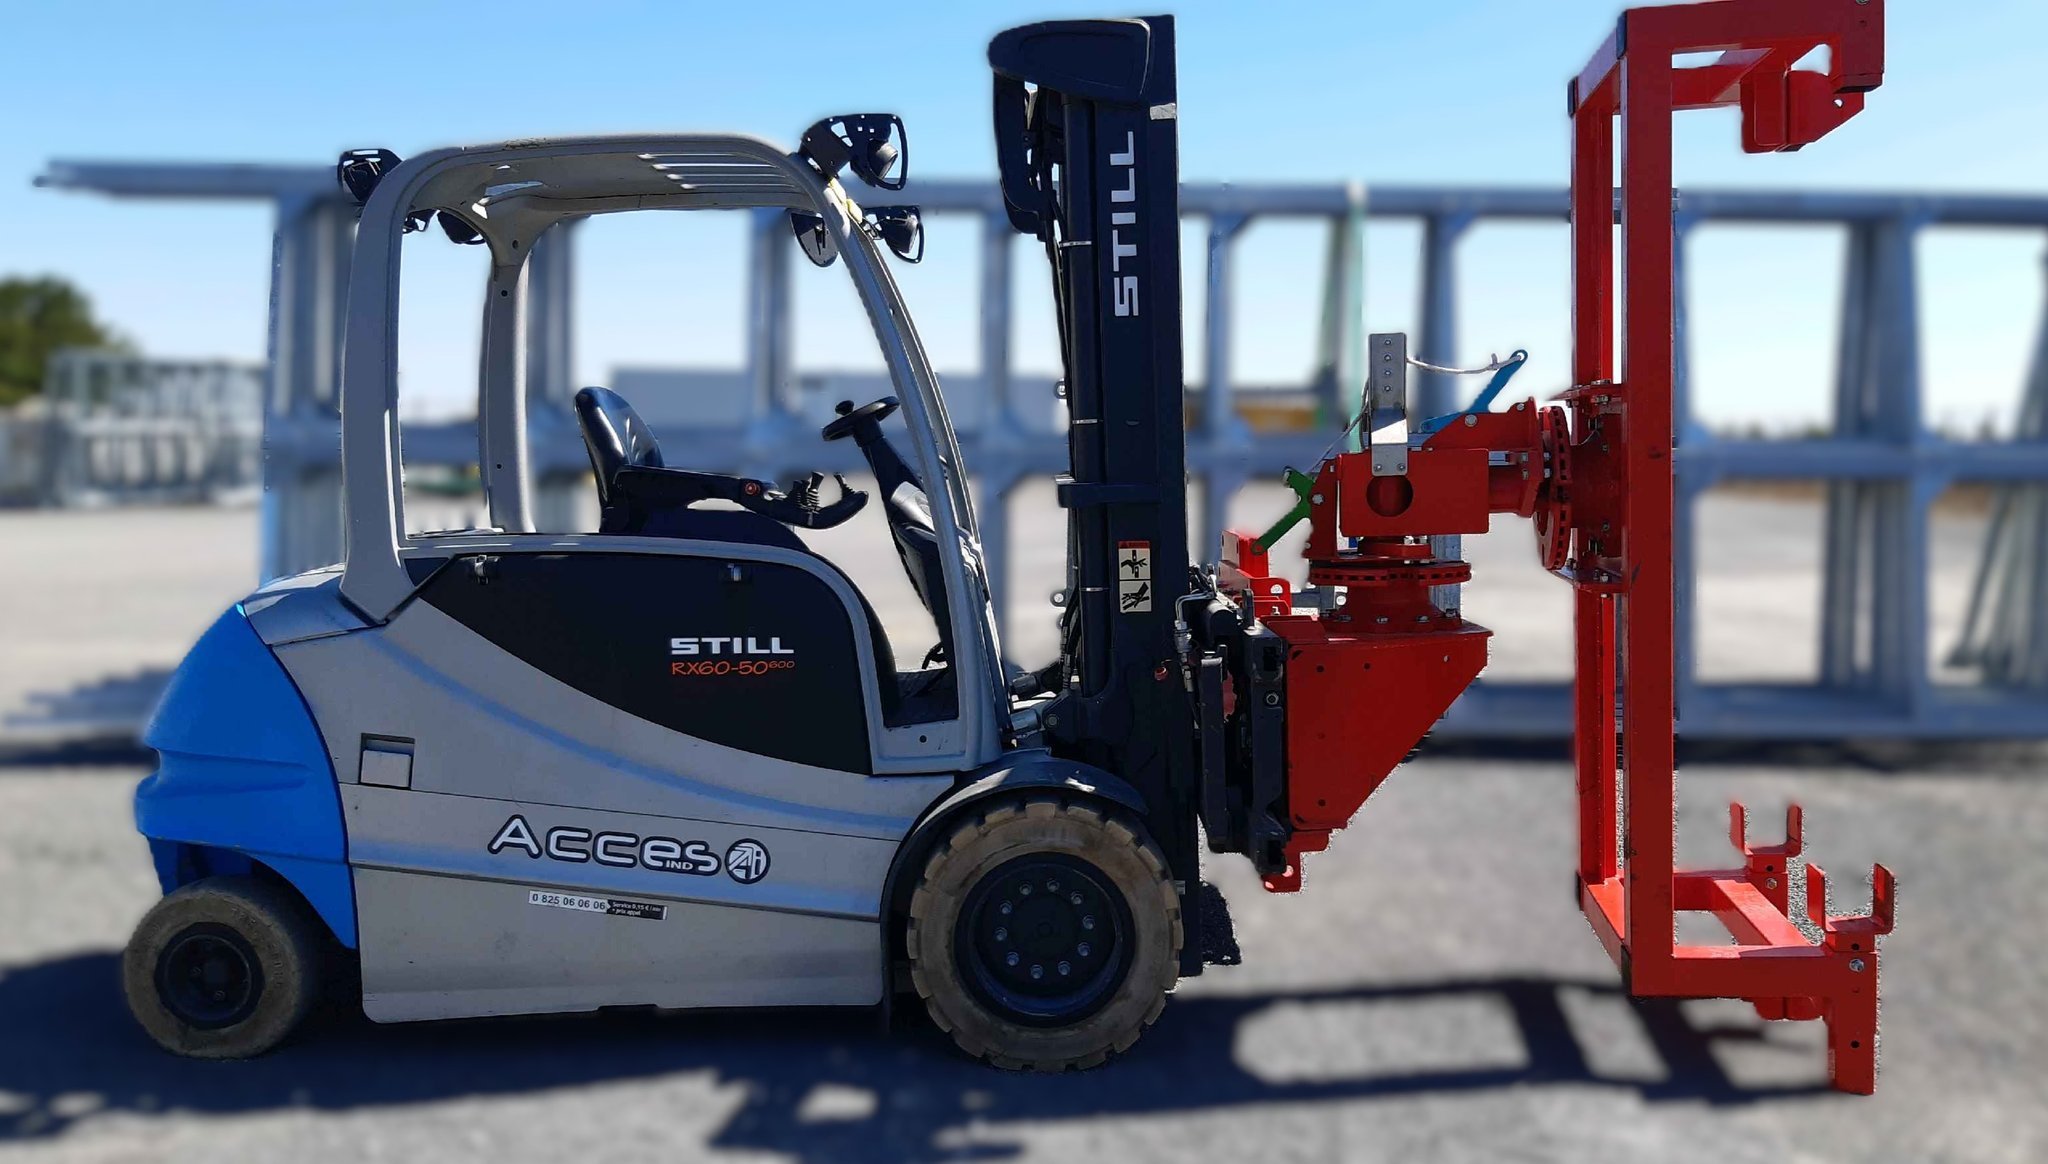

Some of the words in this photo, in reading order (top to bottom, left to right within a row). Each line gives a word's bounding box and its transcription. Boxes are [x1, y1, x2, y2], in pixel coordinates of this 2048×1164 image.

[1110, 131, 1139, 316] STILL
[671, 637, 794, 655] STILL
[489, 816, 720, 875] Acces
[666, 860, 693, 870] IND
[532, 893, 539, 902] 0
[541, 895, 560, 905] 825
[563, 897, 575, 906] 06
[578, 899, 590, 908] 06
[593, 901, 606, 910] 06
